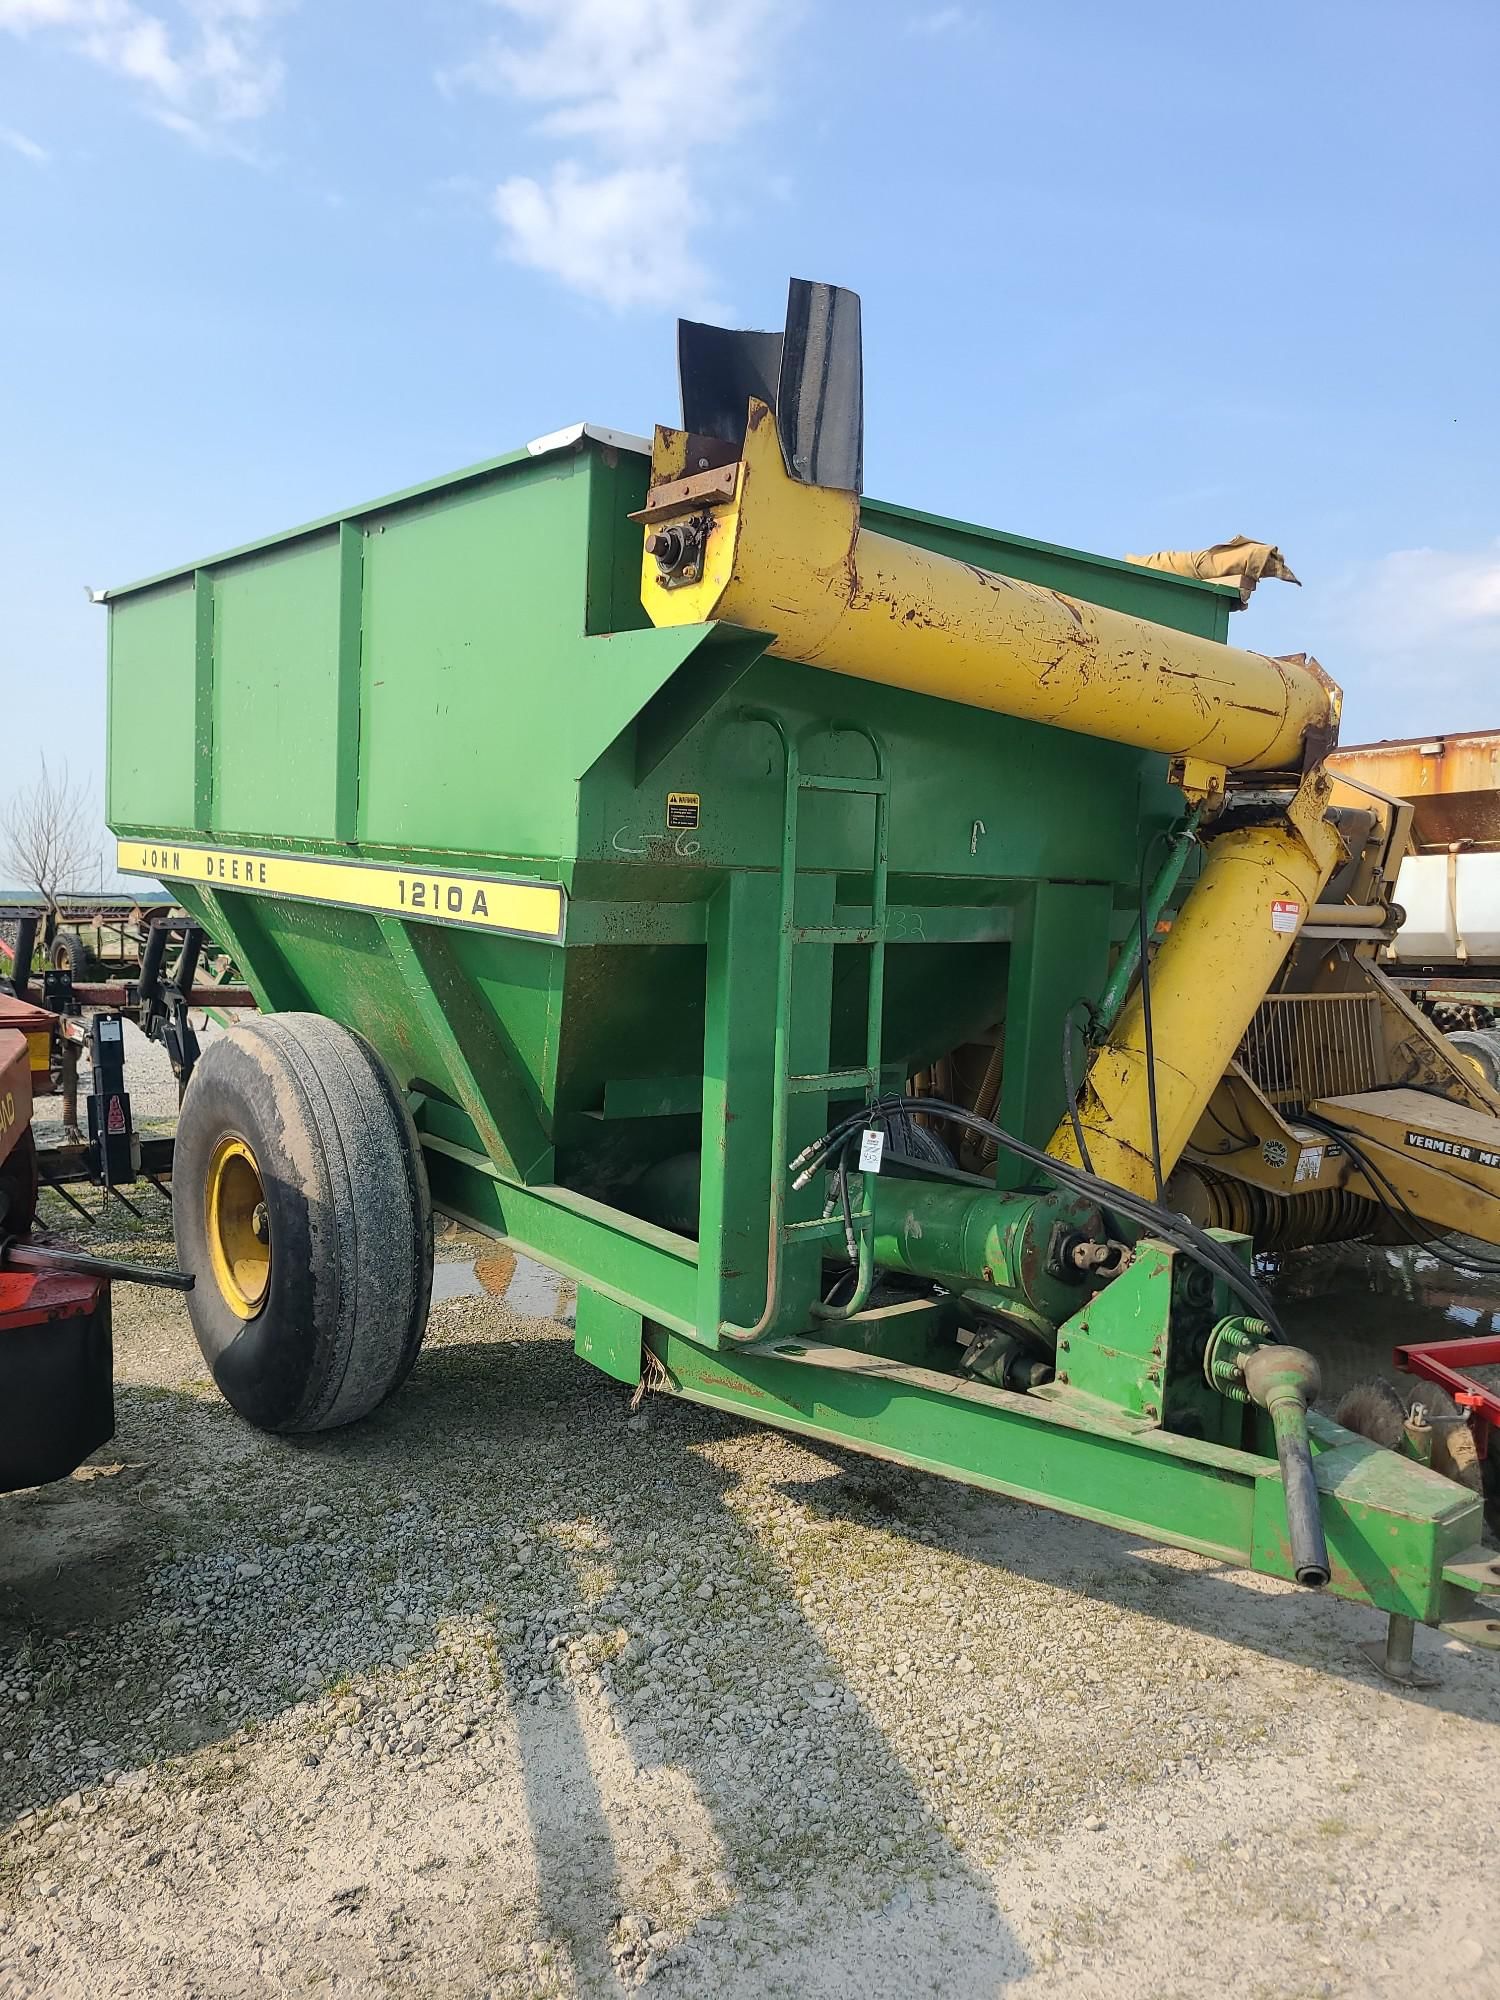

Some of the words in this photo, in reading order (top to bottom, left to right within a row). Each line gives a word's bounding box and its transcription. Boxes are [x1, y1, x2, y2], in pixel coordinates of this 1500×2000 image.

[142, 849, 180, 871] JOHN
[207, 856, 267, 884] DEERE
[398, 879, 488, 917] 1210A
[1265, 1140, 1286, 1154] SUPER
[1409, 1133, 1471, 1160] VERMEER
[1478, 1151, 1500, 1168] MF
